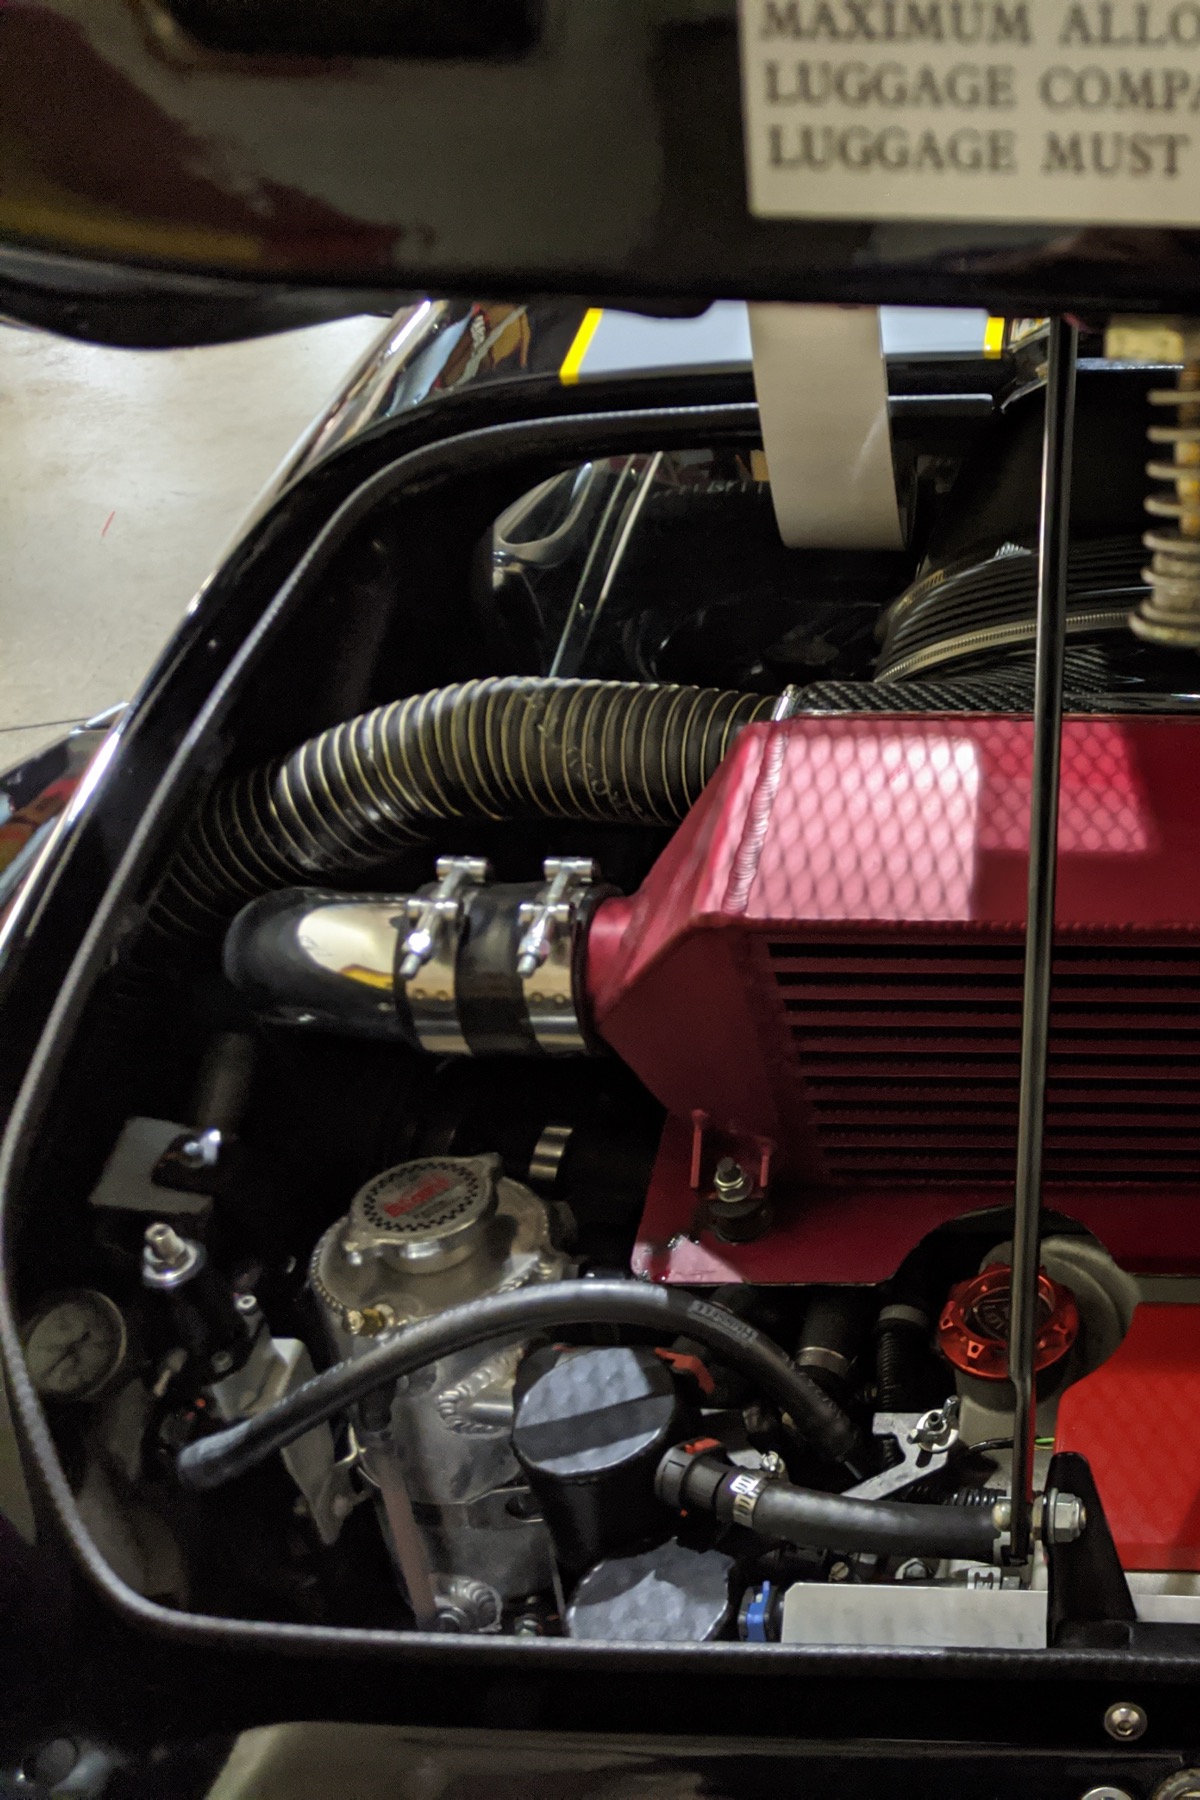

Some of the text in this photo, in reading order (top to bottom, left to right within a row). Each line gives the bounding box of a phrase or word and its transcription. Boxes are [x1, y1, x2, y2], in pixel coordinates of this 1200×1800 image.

[760, 0, 1033, 46] MAXIMUM
[763, 59, 1017, 111] LUGGAGE
[767, 123, 1018, 172] LUGGAGE
[1040, 130, 1191, 179] MUST
